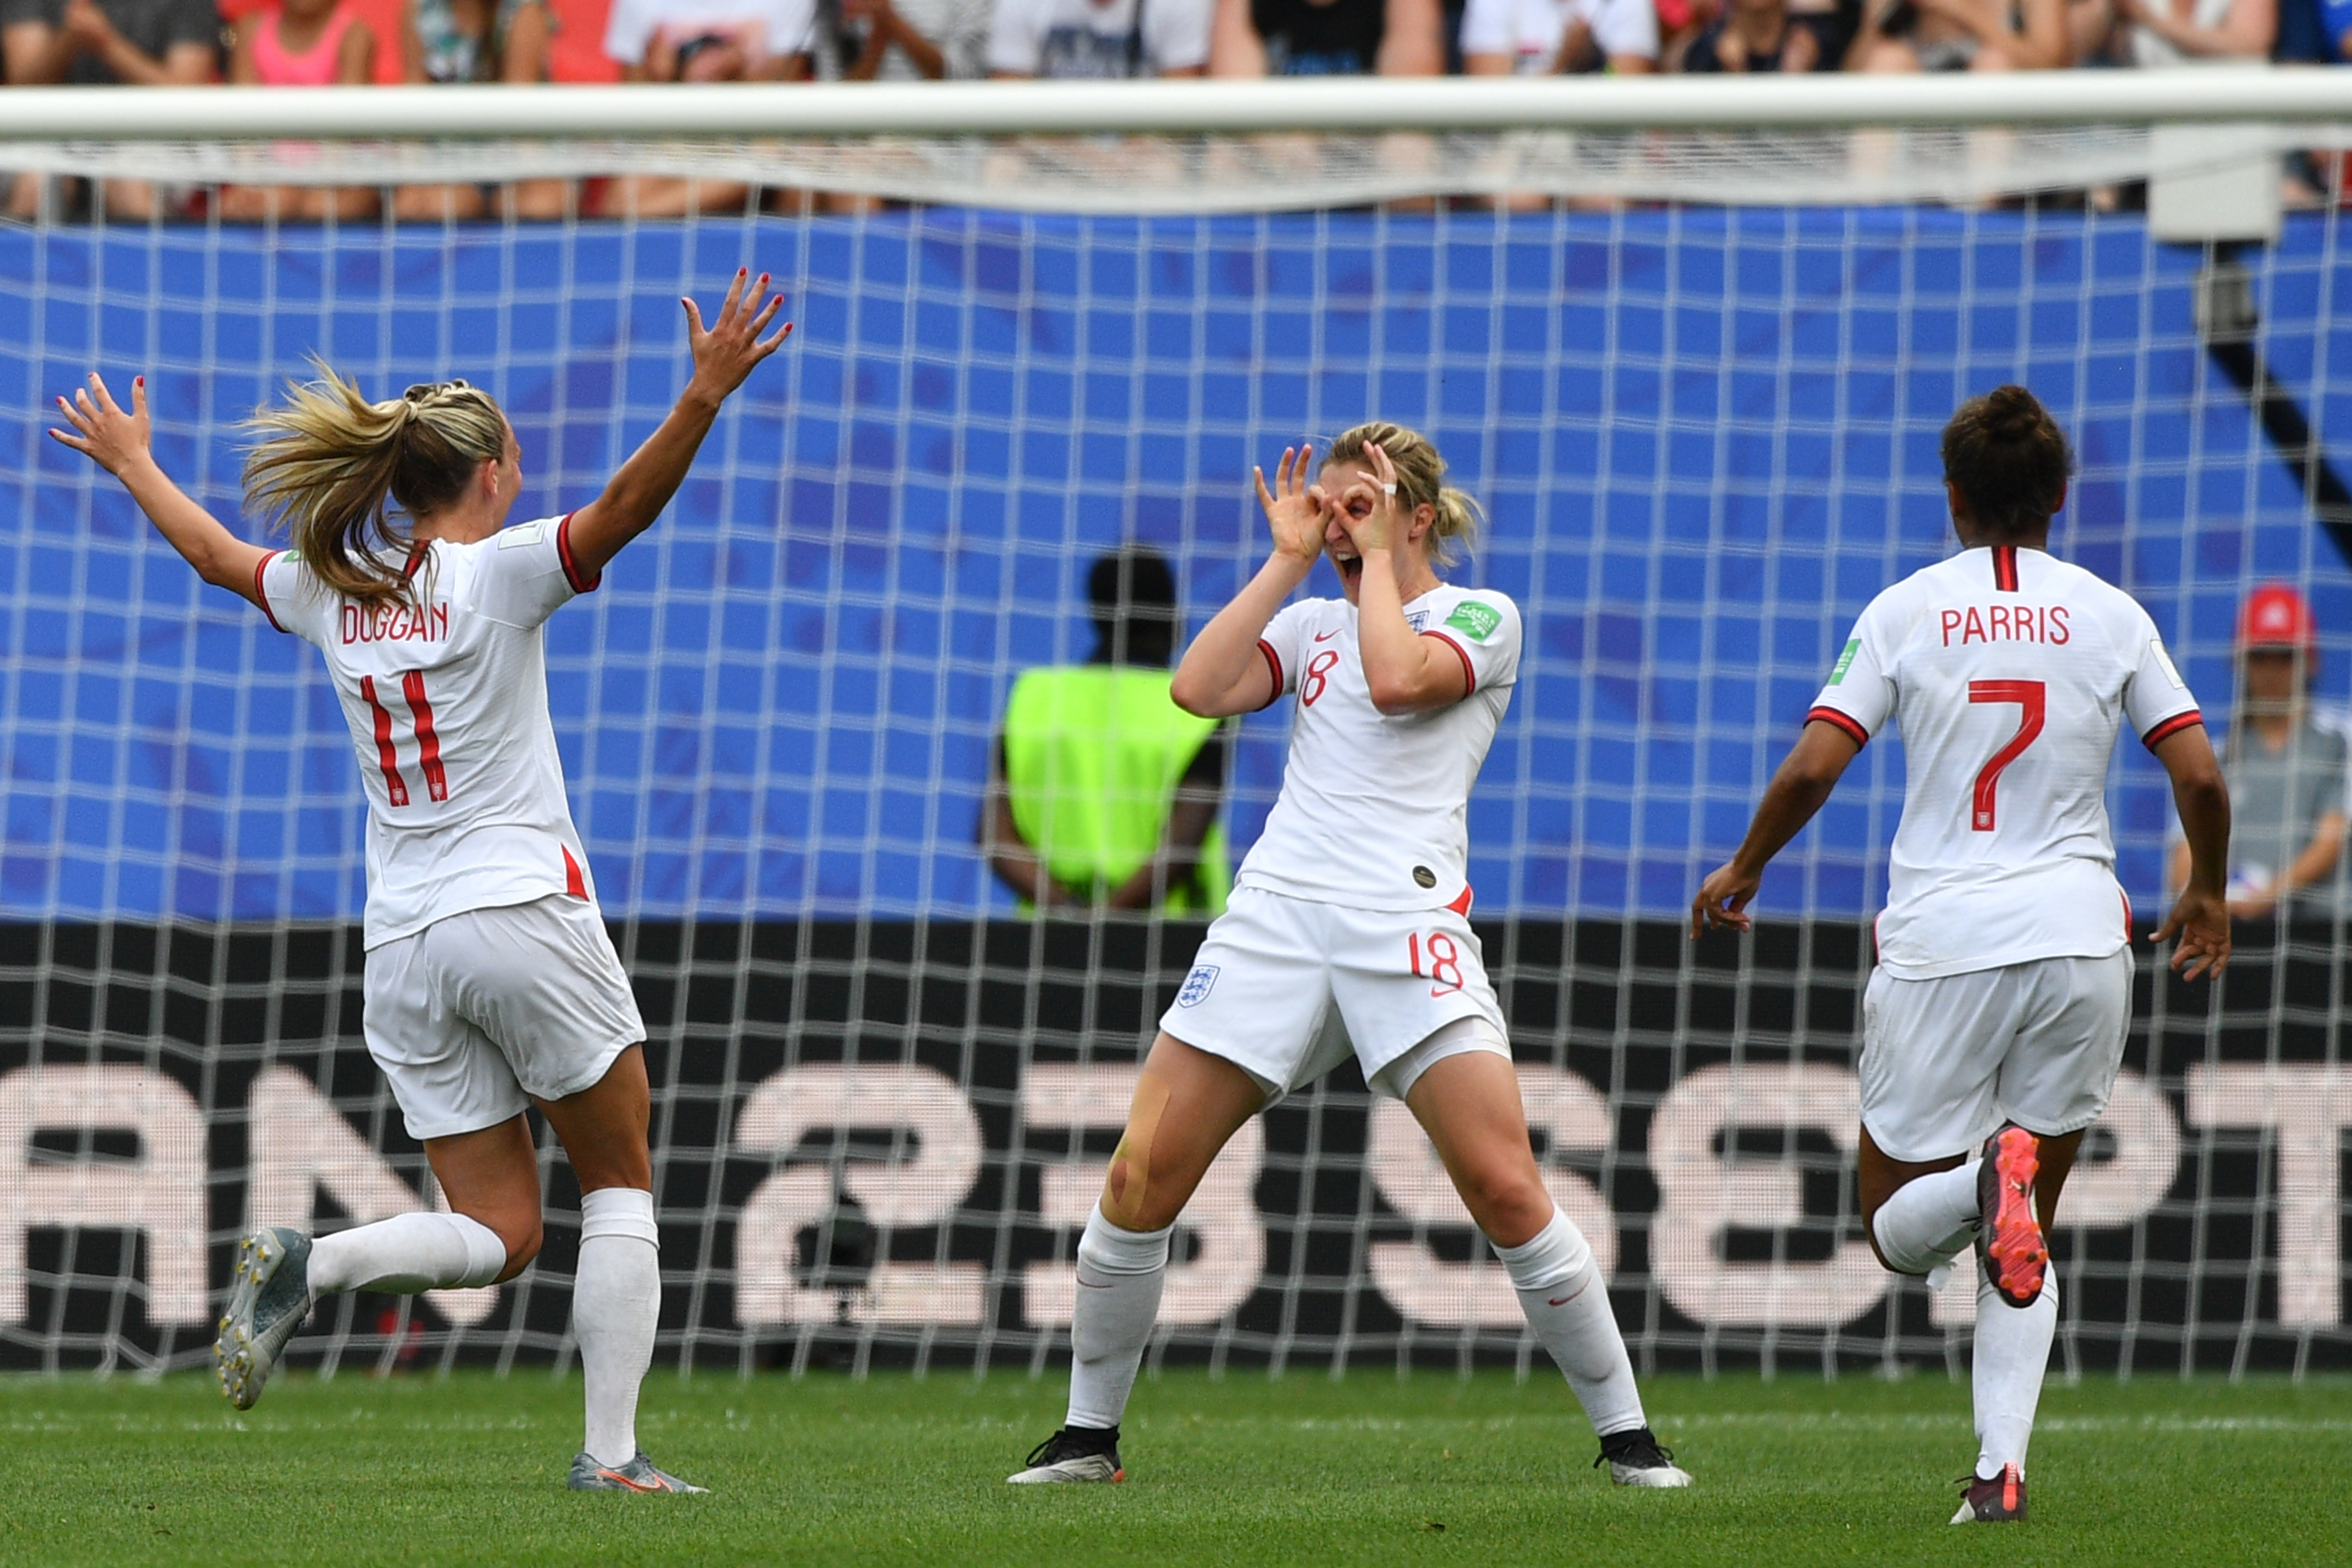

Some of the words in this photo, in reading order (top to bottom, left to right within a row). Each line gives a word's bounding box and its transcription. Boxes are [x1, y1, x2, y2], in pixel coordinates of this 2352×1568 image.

[343, 602, 447, 644] DUGGAN
[1941, 606, 2070, 647] PARRIS
[360, 670, 448, 806] 11
[1968, 680, 2045, 831] 7
[1409, 931, 1463, 988] 18
[734, 1062, 1265, 1326] 23
